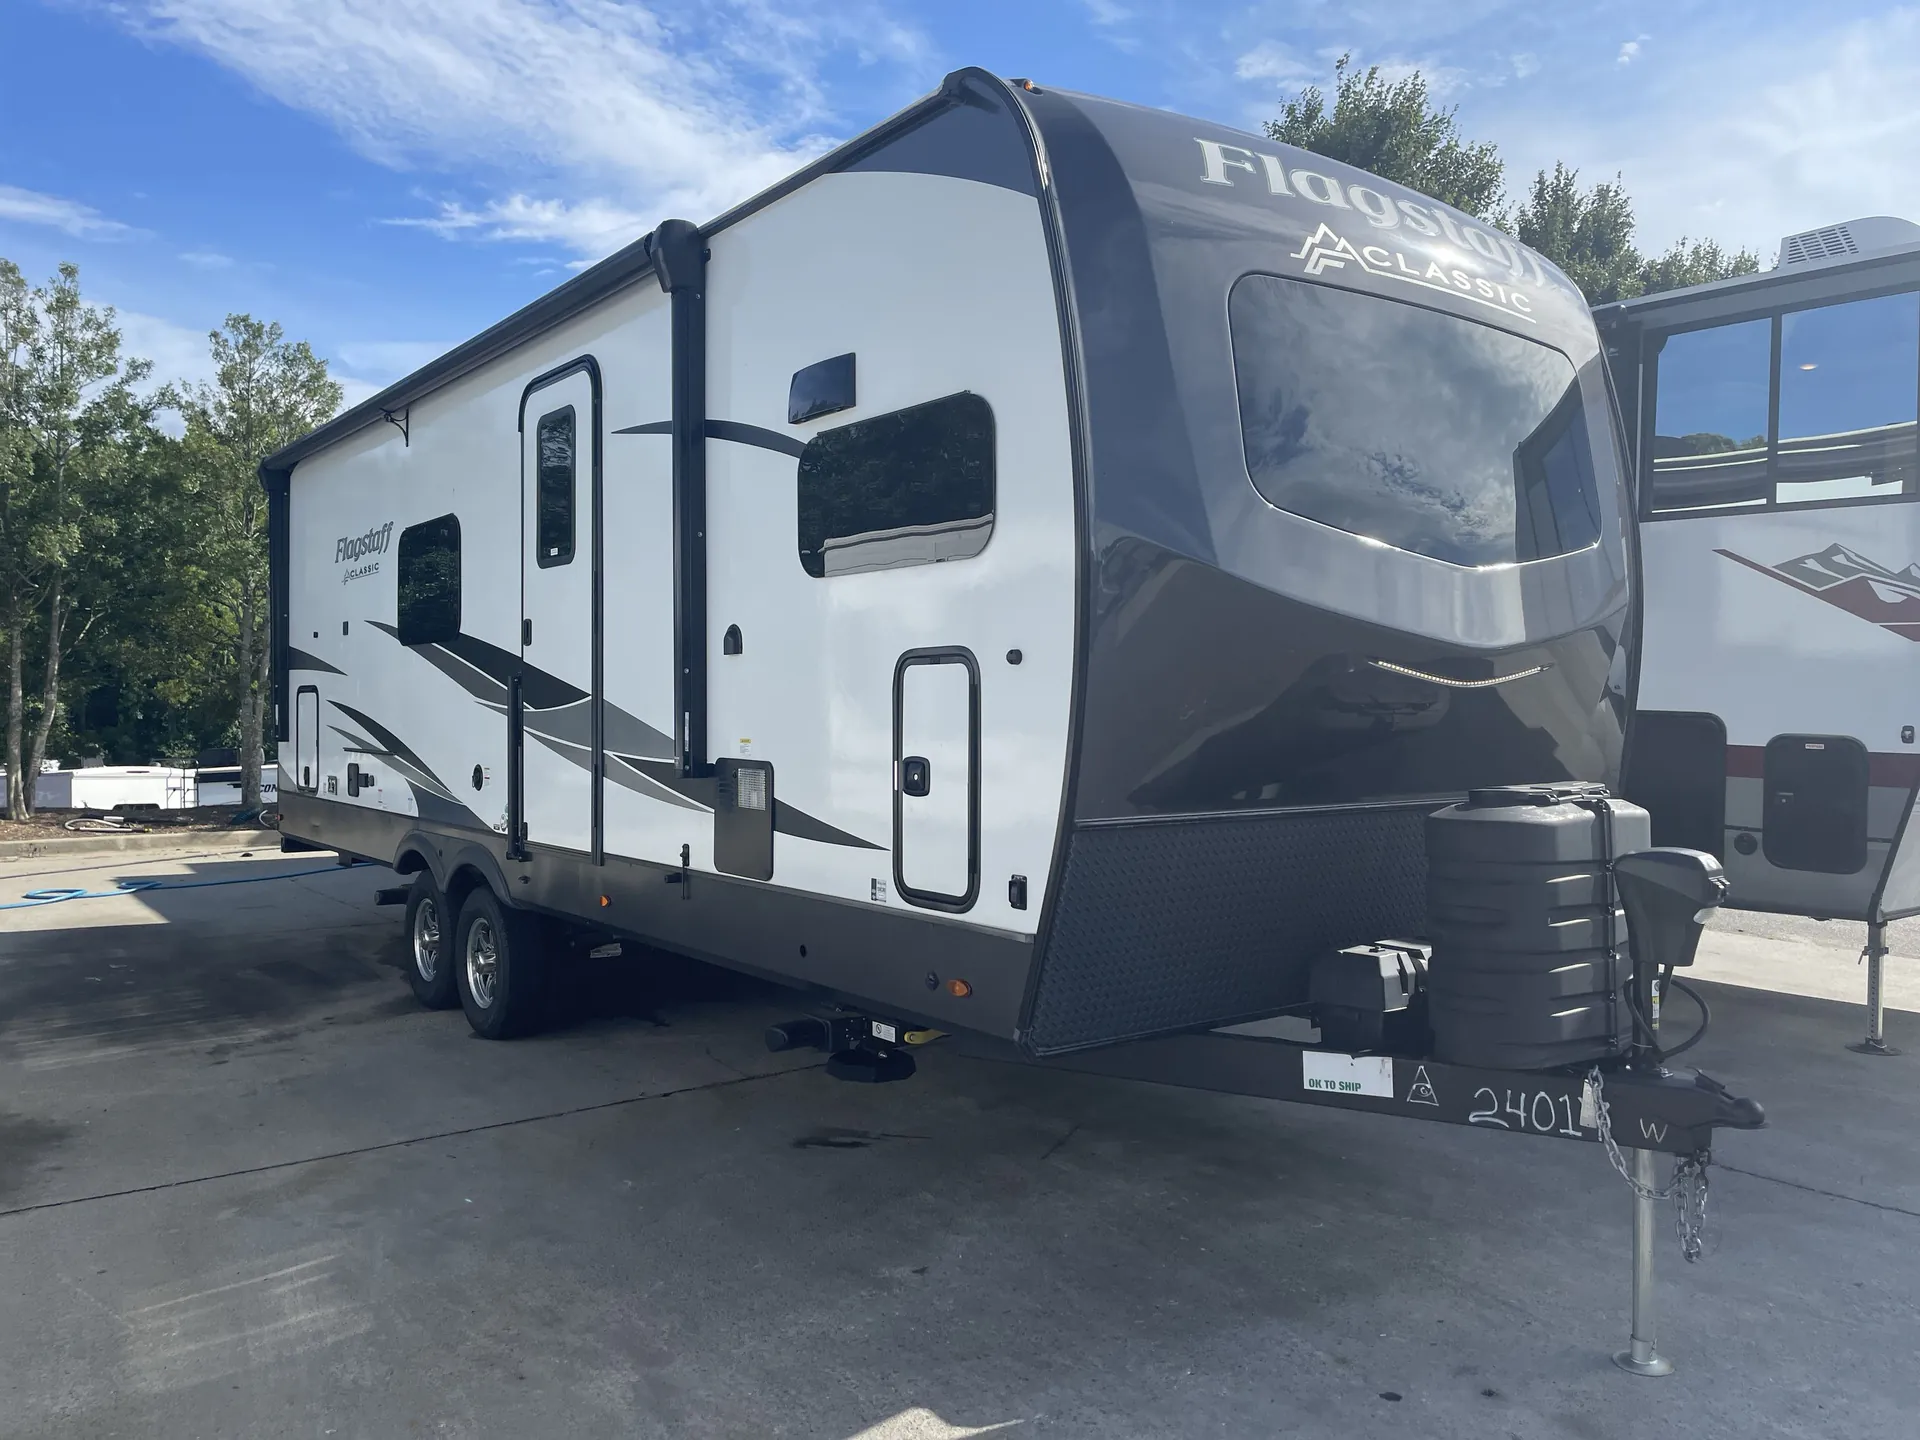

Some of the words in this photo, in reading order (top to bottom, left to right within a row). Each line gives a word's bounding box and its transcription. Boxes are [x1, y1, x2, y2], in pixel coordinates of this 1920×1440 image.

[1194, 137, 1546, 288] Flagstaff
[1362, 246, 1532, 313] CLASSIC
[334, 520, 394, 564] Flagstaff
[350, 562, 380, 578] CLASSIC
[1308, 1078, 1322, 1089] OK
[1324, 1079, 1336, 1090] TO
[1338, 1081, 1362, 1092] SHIP
[1639, 1117, 1669, 1144] W
